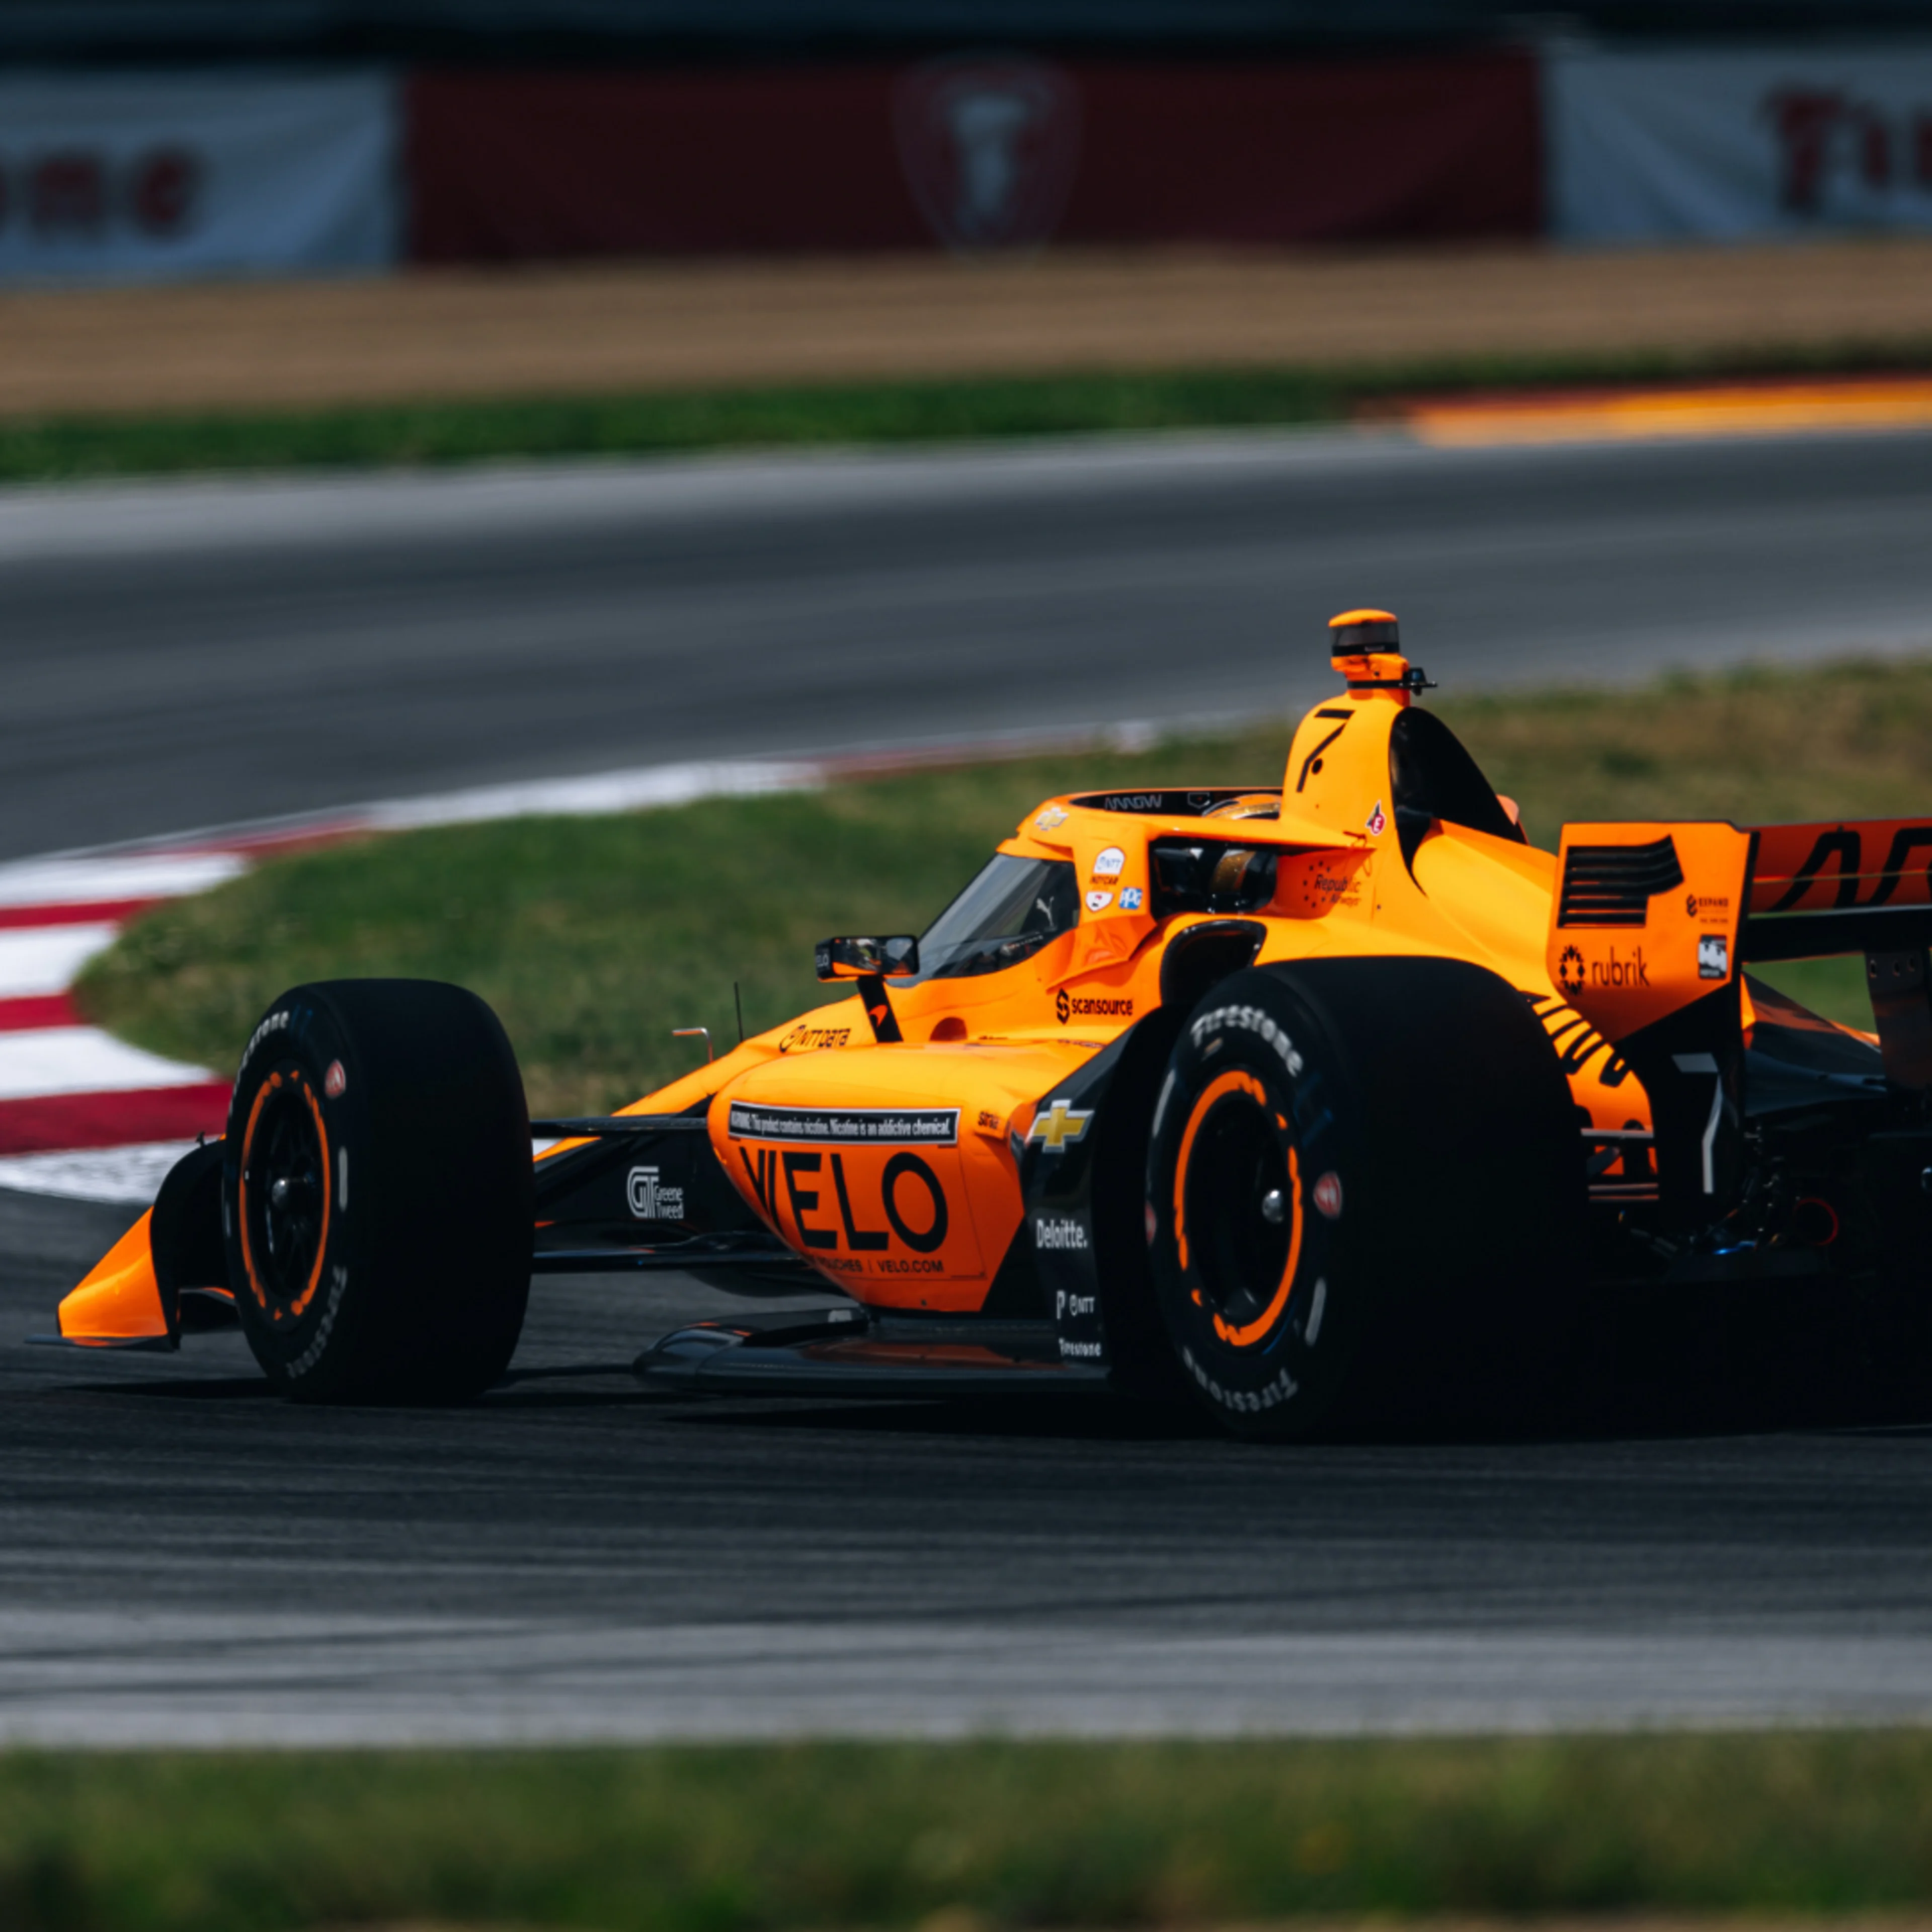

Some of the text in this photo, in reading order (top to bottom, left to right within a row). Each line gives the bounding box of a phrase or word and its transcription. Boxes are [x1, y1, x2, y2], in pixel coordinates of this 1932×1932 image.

[1297, 708, 1355, 793] 7
[1592, 945, 1651, 987] rubrik
[1072, 998, 1134, 1016] scansource
[1189, 1004, 1304, 1078] Firestone
[859, 1118, 866, 1136] is
[867, 1122, 877, 1136] an
[877, 1118, 911, 1136] addictive
[1670, 1051, 1724, 1194] 7
[739, 1146, 948, 1253] VELO
[1035, 1218, 1088, 1249] Deloitte.
[877, 1259, 944, 1273] VELO.COM
